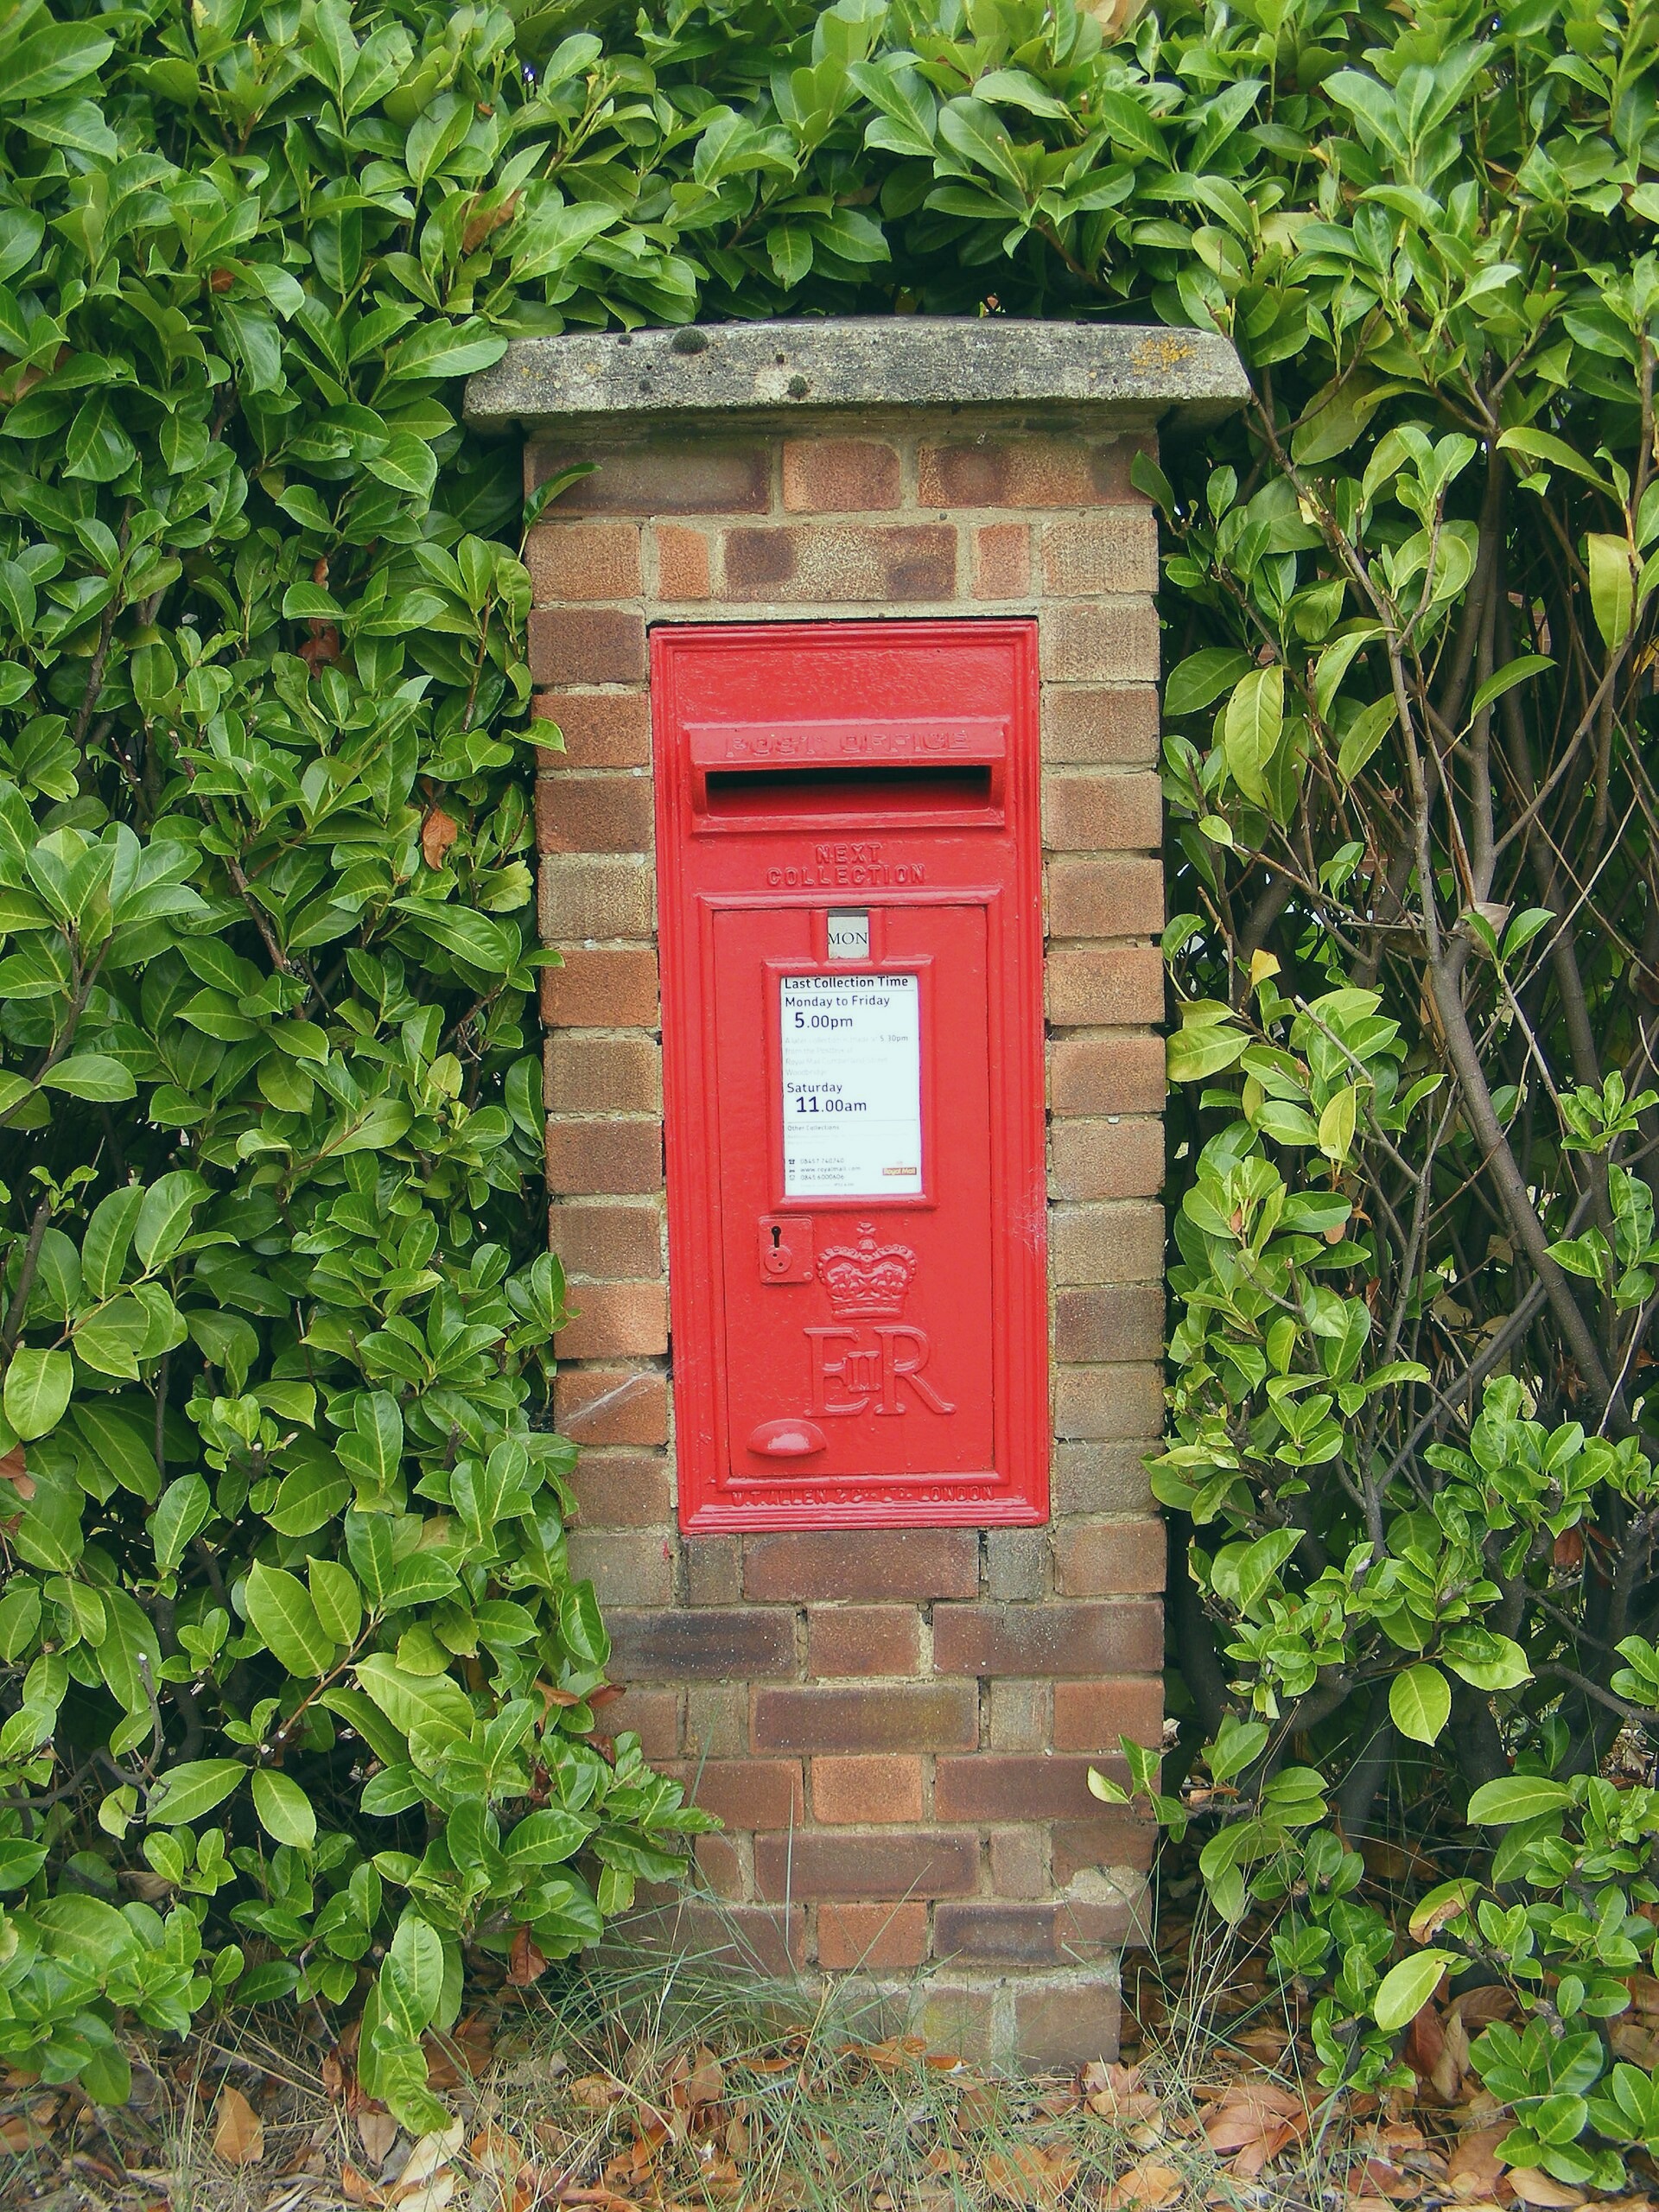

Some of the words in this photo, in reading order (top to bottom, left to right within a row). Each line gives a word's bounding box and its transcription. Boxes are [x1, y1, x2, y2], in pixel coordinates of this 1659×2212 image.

[725, 733, 824, 758] POST
[840, 730, 971, 754] OFFICE
[815, 842, 882, 864] NEXT
[766, 864, 925, 887] COLLECTION
[828, 932, 868, 945] MON
[785, 978, 810, 989] Last
[814, 976, 874, 988] Collection
[877, 976, 908, 987] Time
[785, 996, 833, 1008] Monday
[836, 997, 849, 1006] to
[851, 995, 890, 1007] Friday
[794, 1012, 854, 1030] 5.00pm
[880, 1034, 909, 1043] 530pm
[786, 1082, 842, 1095] Saturday
[796, 1096, 868, 1113] 11.00am
[918, 1484, 994, 1503] LONDON
